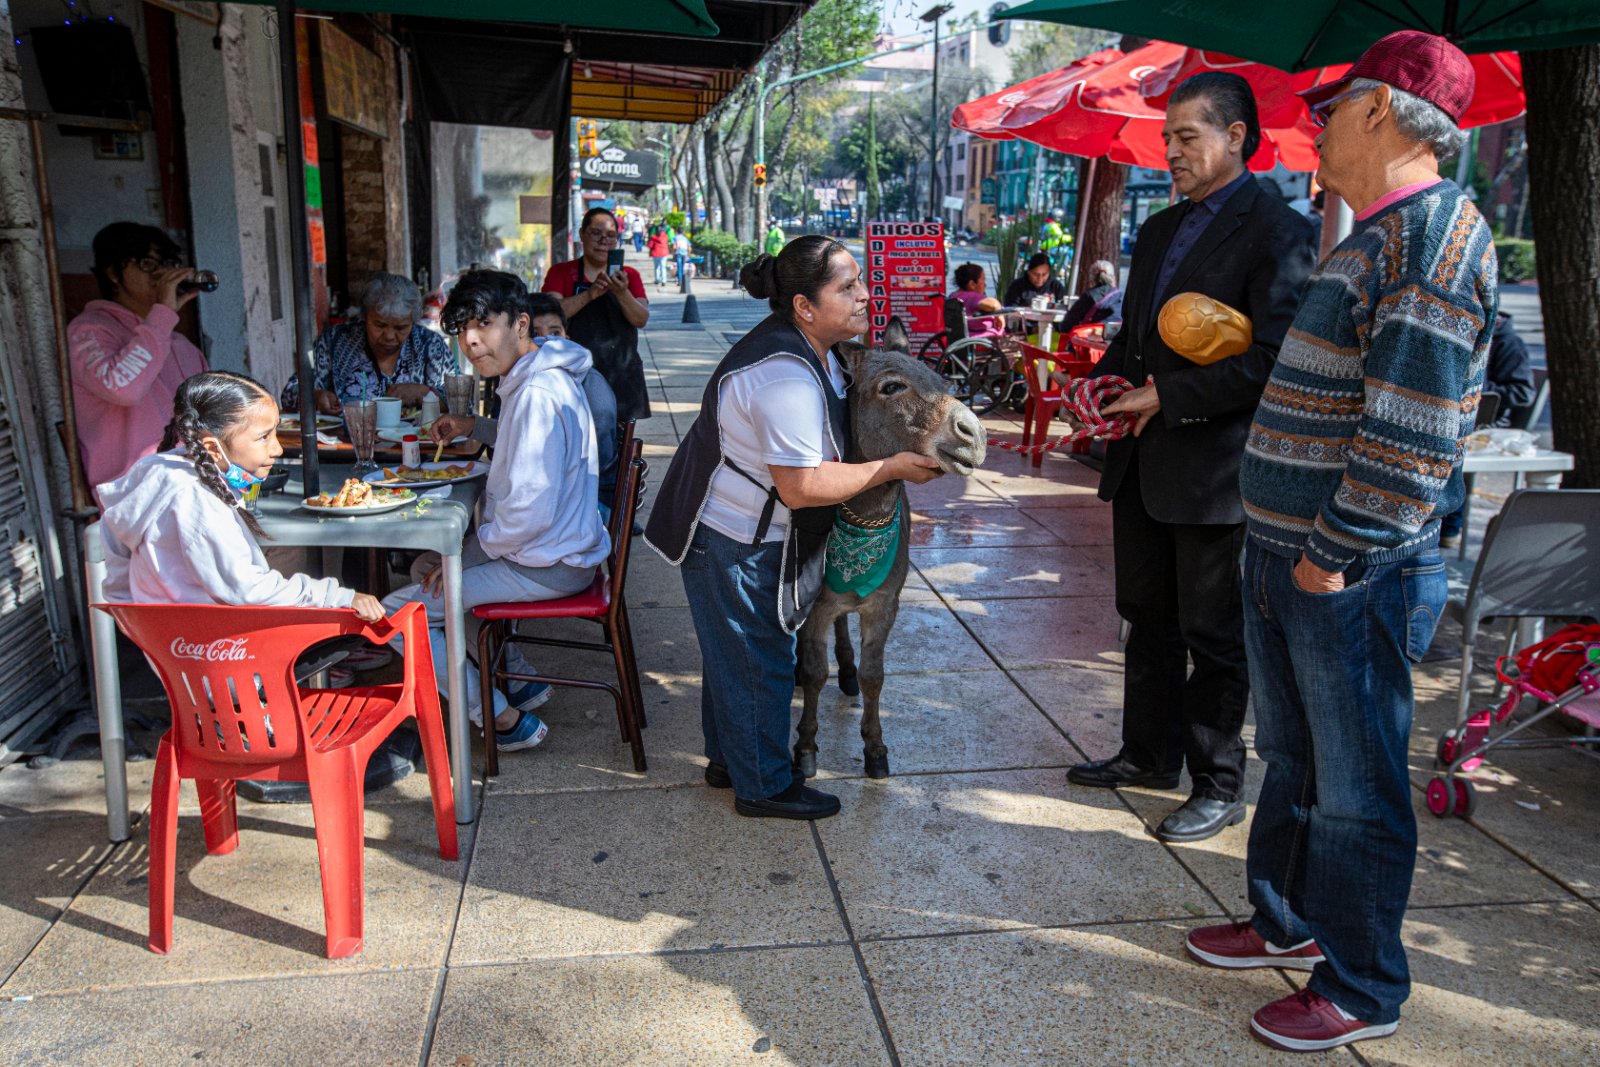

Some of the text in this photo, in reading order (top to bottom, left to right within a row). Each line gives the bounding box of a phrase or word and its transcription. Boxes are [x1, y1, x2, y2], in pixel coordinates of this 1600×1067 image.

[584, 156, 641, 178] Corona
[871, 223, 941, 236] RICOS
[895, 240, 936, 248] INCLUYEN
[871, 239, 888, 352] DESAYUN
[170, 636, 249, 662] Coca-Cola
